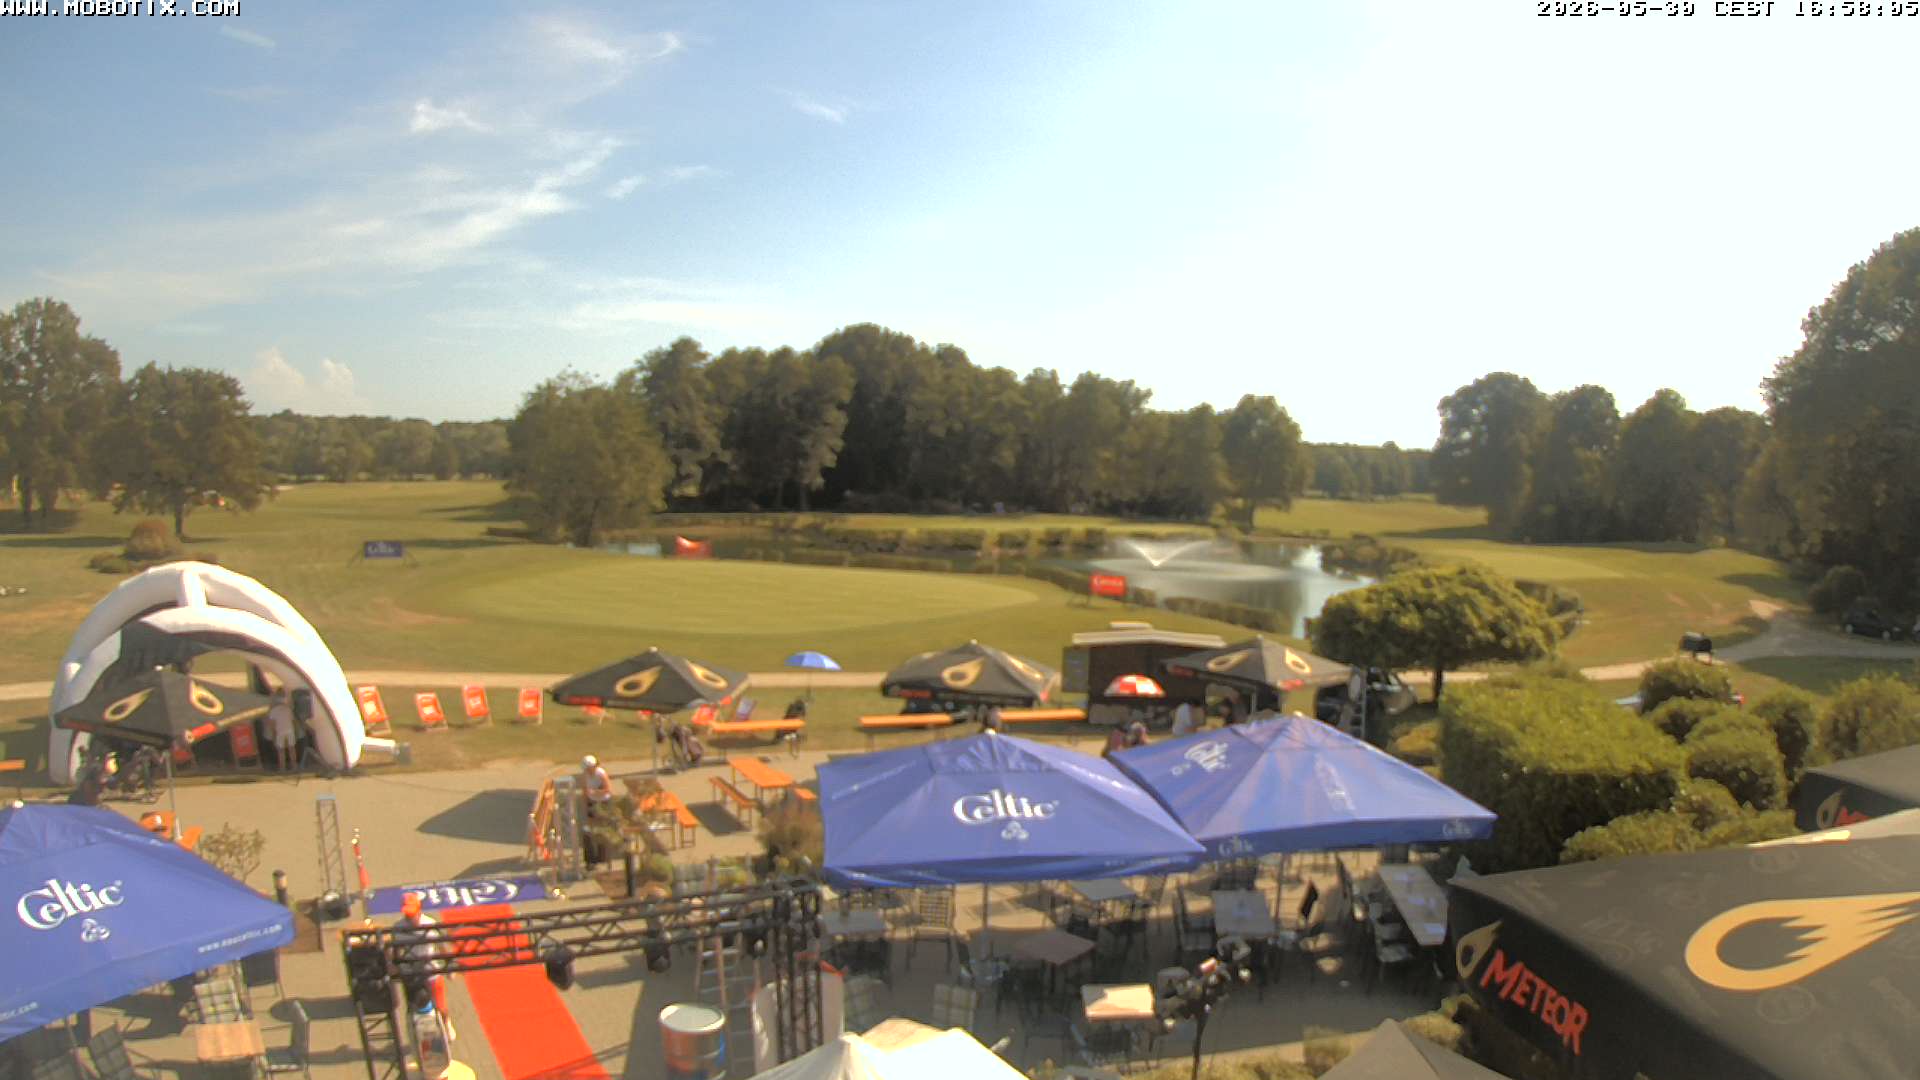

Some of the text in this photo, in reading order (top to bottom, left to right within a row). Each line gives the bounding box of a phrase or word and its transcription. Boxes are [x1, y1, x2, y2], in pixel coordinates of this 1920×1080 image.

[953, 788, 1055, 824] Celtic
[17, 878, 124, 930] Celtic
[1480, 949, 1590, 1055] METEOR
